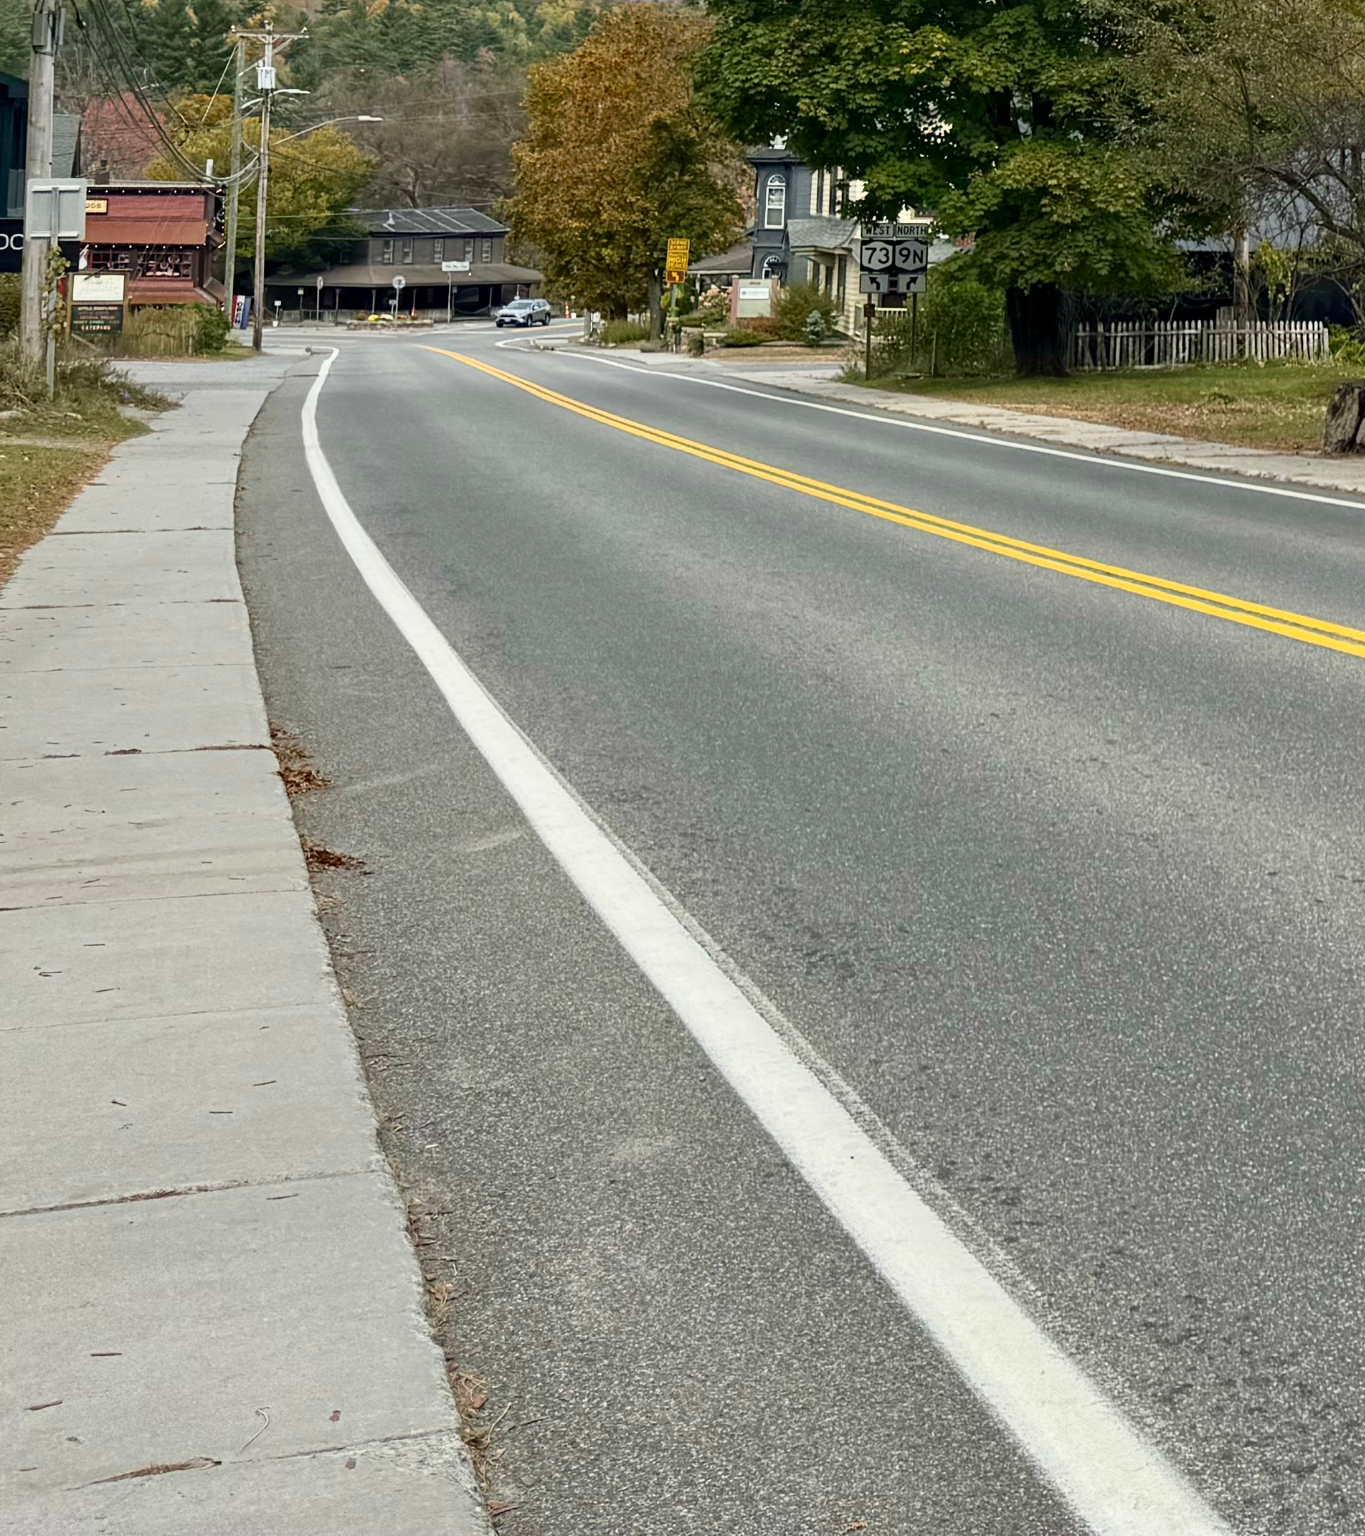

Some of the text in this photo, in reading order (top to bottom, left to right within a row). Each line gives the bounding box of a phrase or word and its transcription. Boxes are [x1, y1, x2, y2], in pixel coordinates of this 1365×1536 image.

[865, 225, 891, 235] WEST
[897, 225, 927, 236] NORTH
[864, 247, 890, 265] 73
[898, 247, 924, 265] 9N
